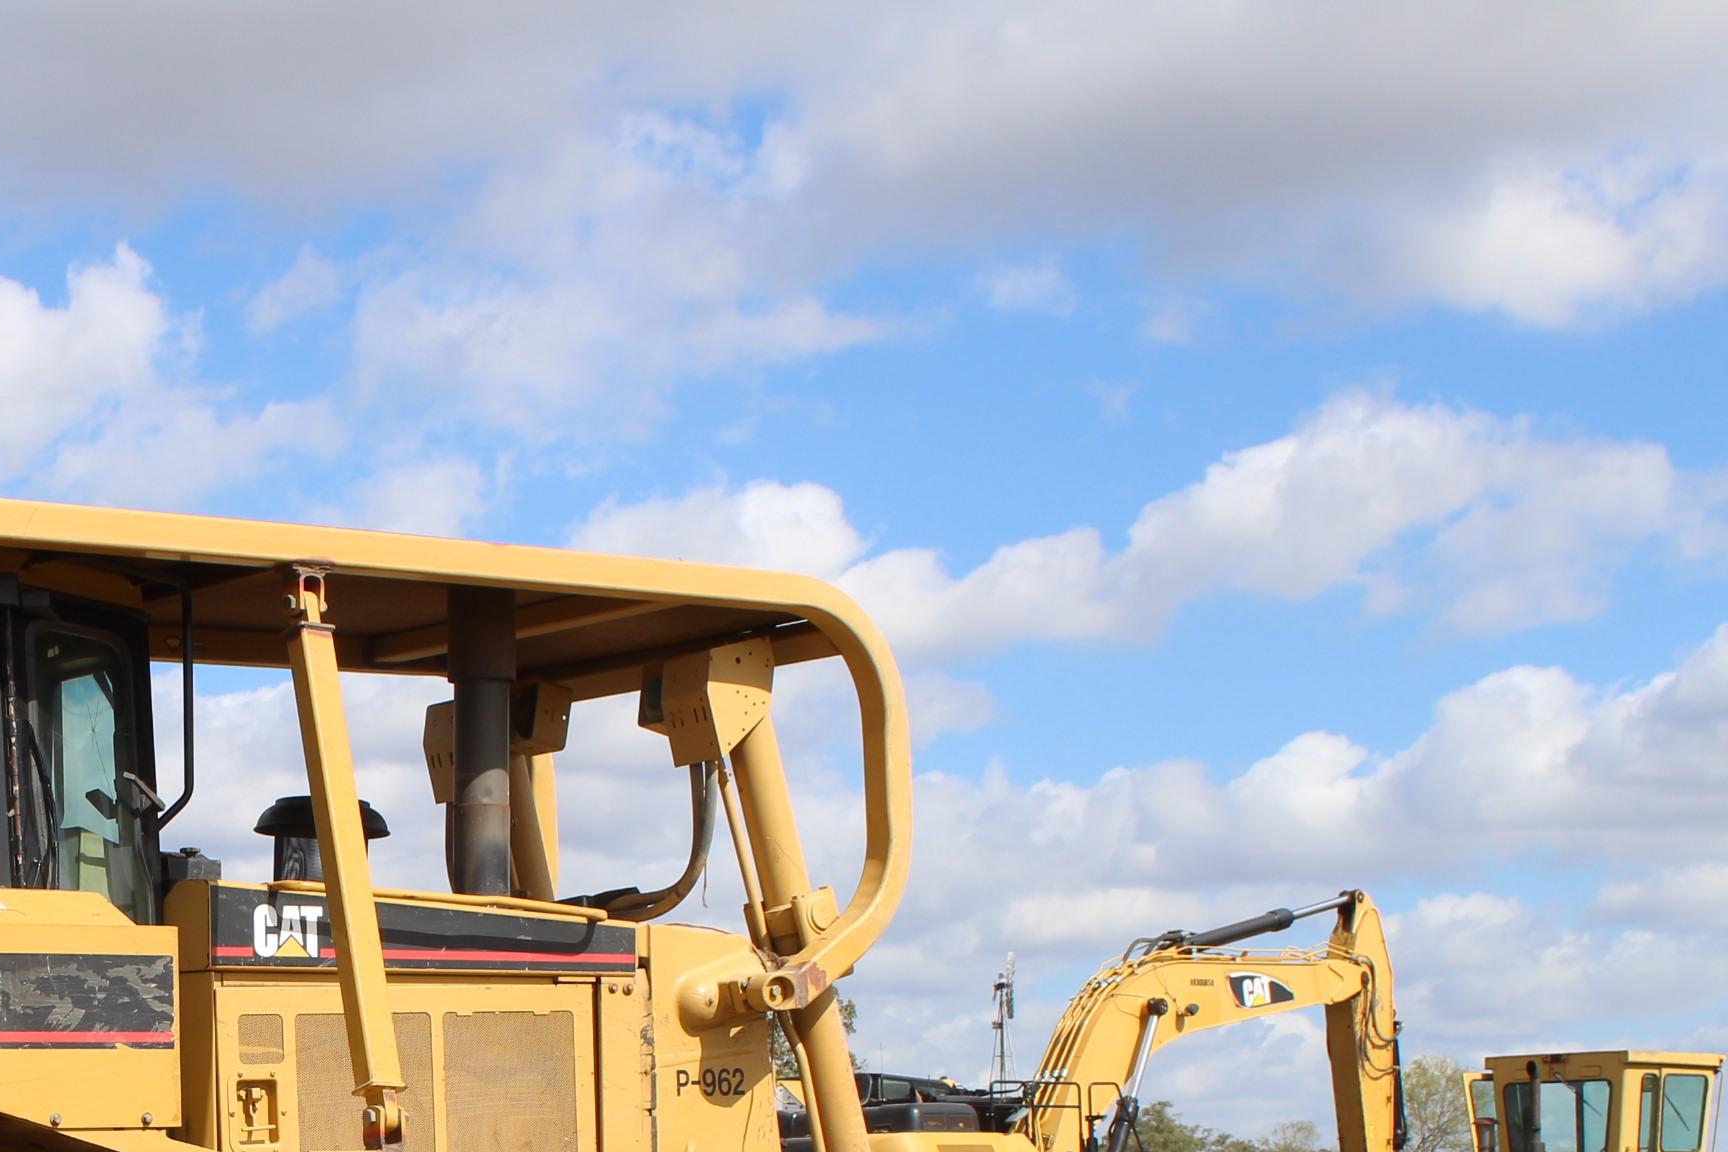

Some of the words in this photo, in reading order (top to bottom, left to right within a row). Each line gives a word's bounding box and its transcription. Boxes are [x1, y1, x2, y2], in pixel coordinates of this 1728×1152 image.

[253, 903, 323, 958] CAT
[1242, 976, 1271, 1008] CAT
[676, 1067, 746, 1097] P-962
